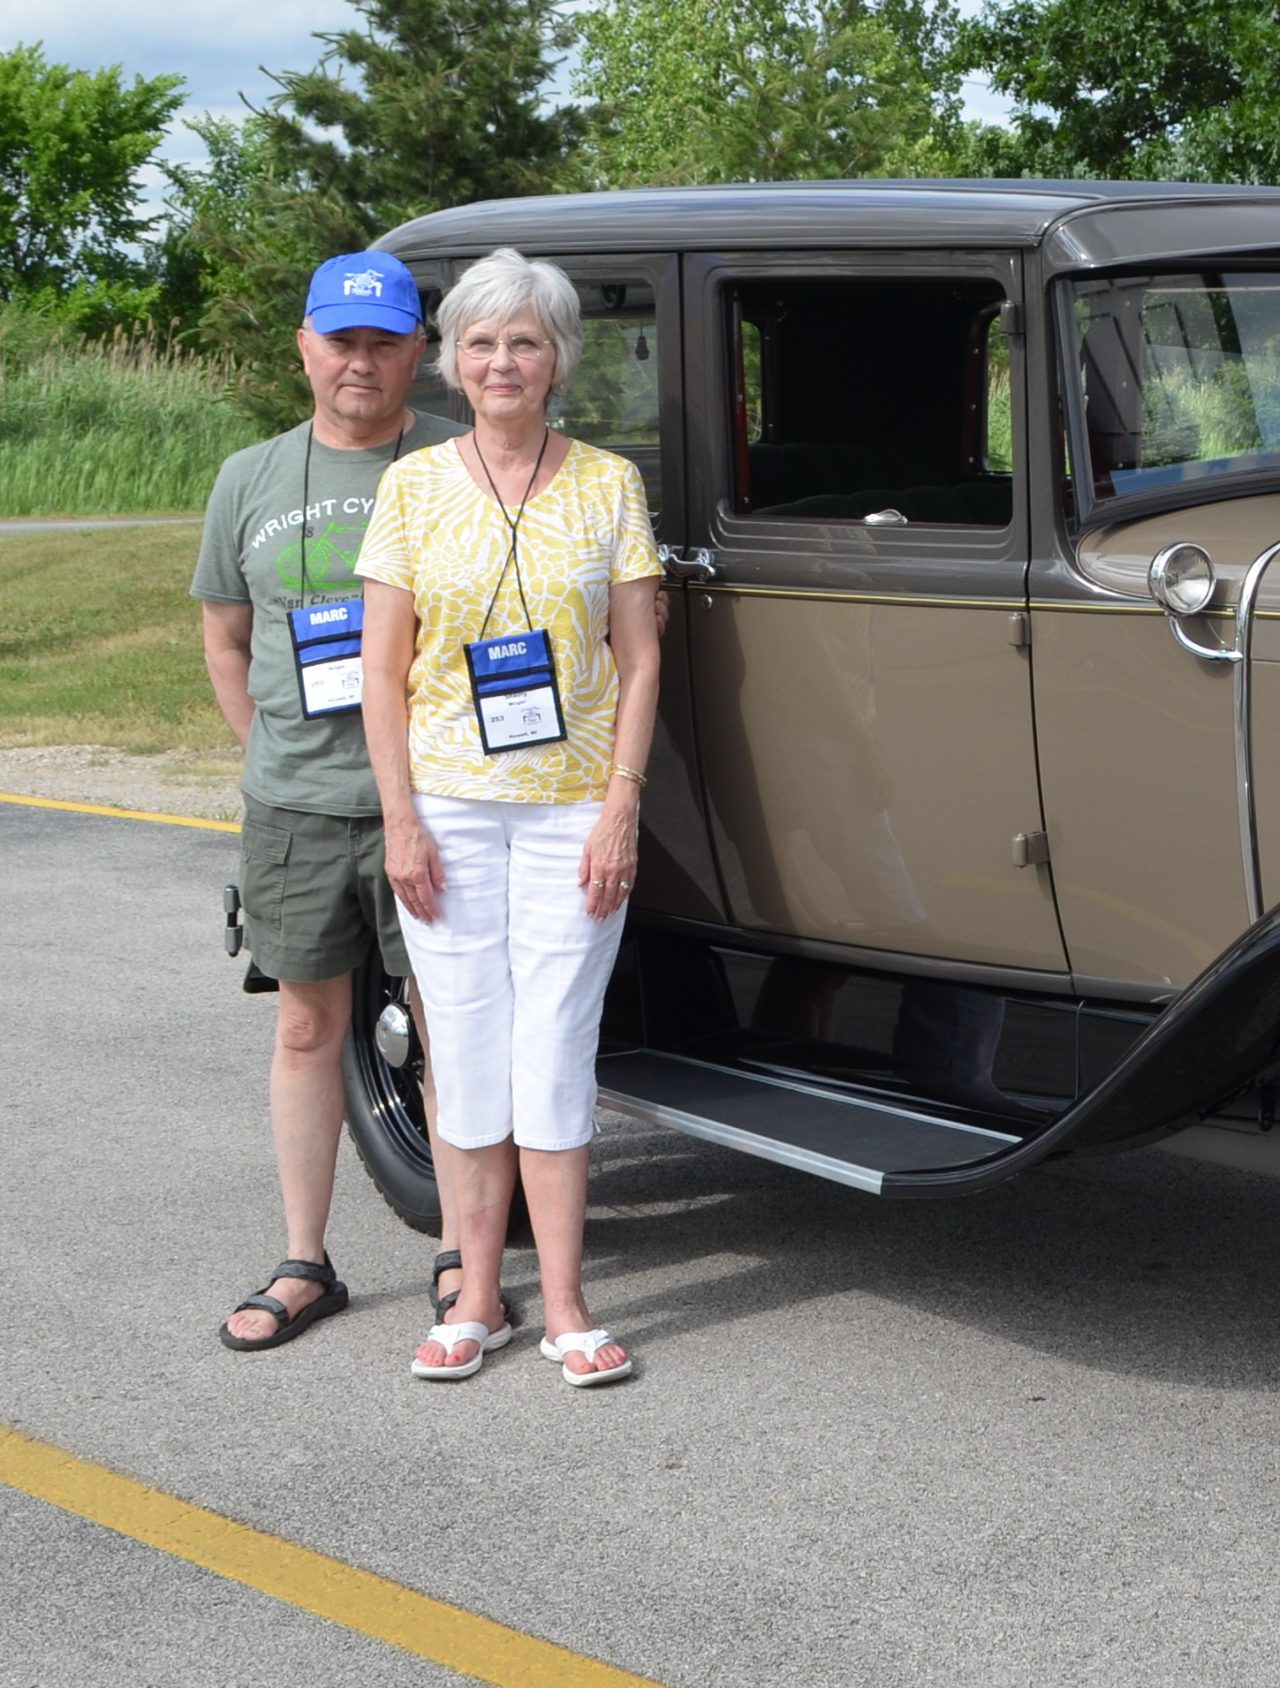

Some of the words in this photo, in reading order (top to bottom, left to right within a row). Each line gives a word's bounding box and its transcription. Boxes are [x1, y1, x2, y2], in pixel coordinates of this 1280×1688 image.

[251, 499, 337, 549] WRIGHT
[343, 497, 374, 514] CY
[309, 607, 348, 625] MARC
[488, 641, 527, 660] MARC
